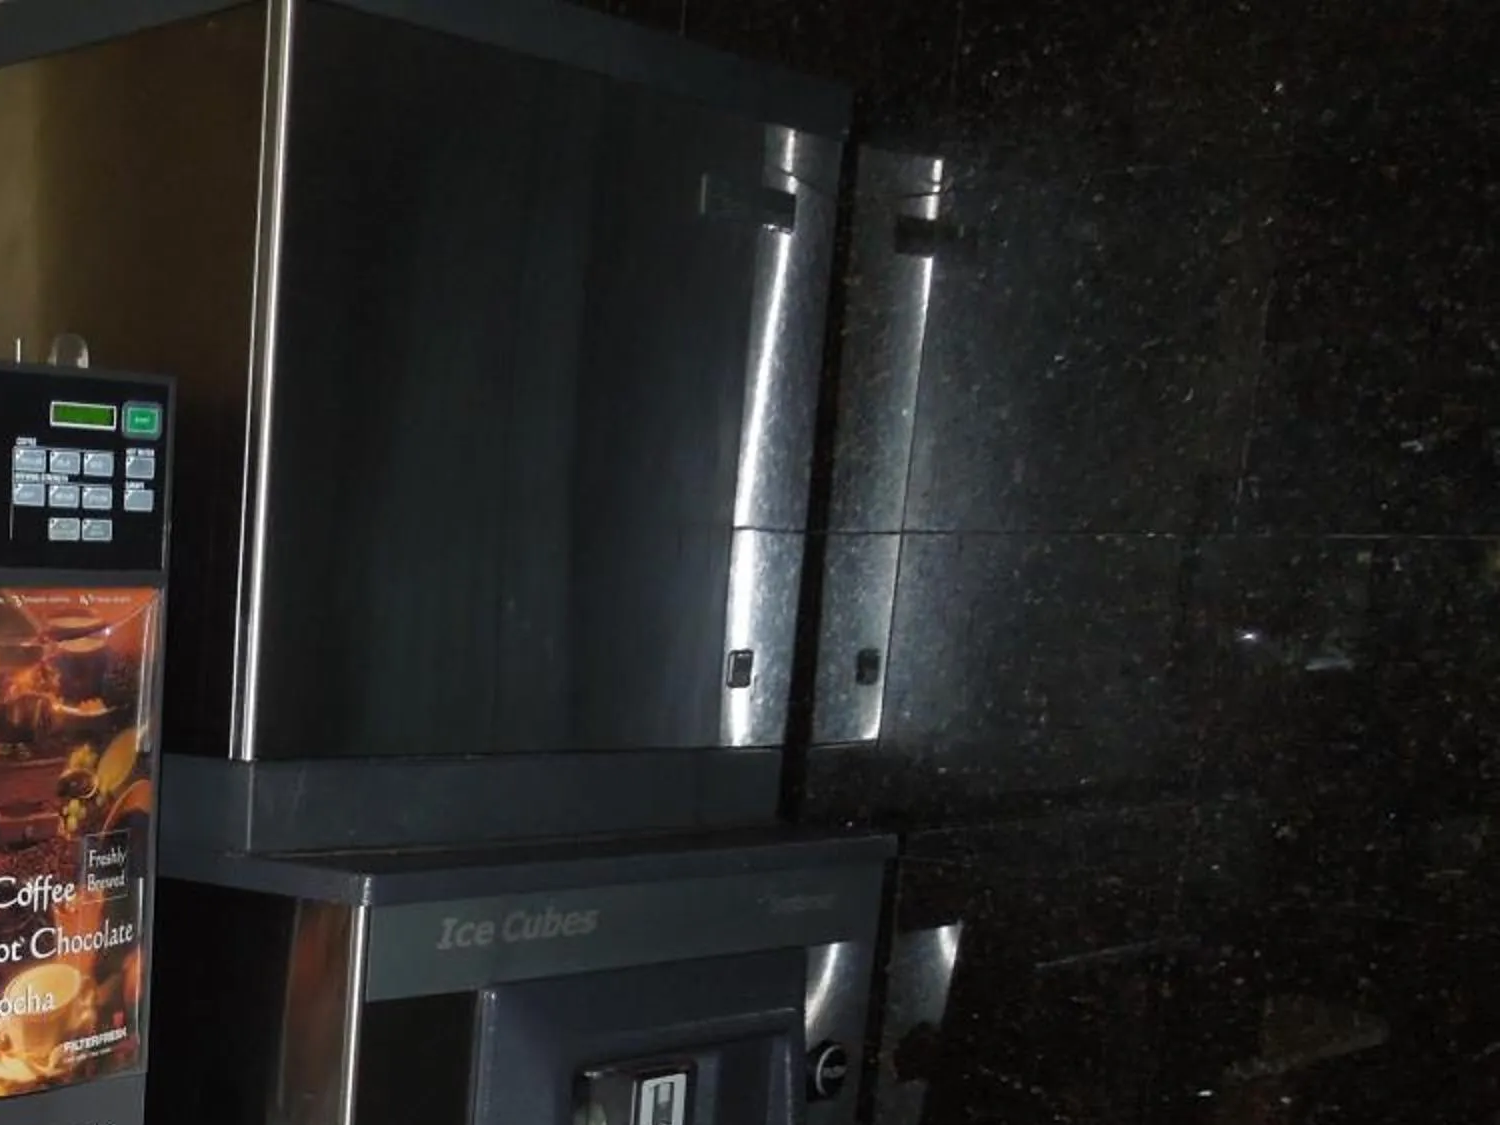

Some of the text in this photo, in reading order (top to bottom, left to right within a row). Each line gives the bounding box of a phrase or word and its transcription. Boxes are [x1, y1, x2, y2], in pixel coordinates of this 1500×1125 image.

[30, 918, 134, 959] Chocolate
[436, 905, 600, 950] Ice Cubes
